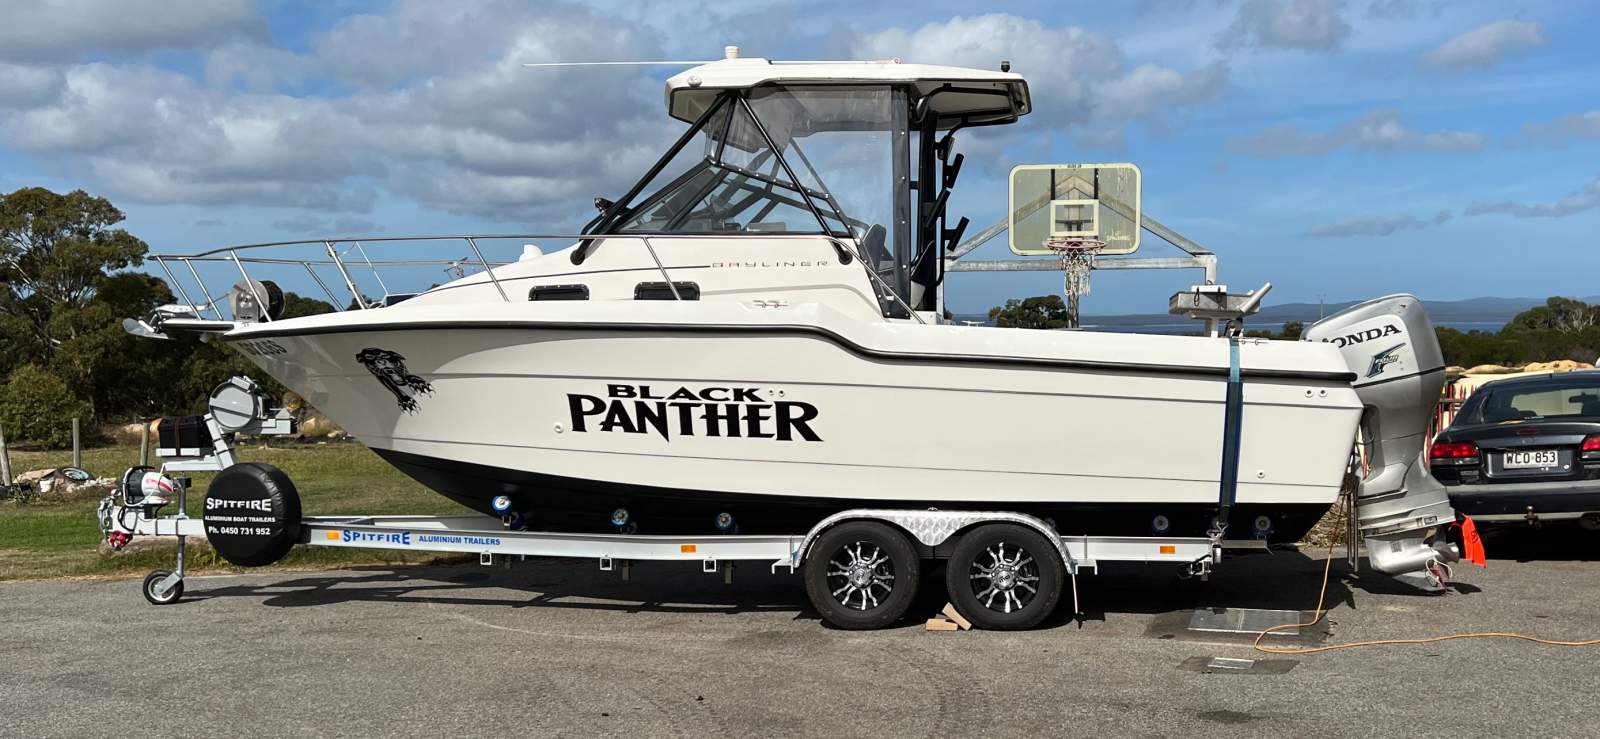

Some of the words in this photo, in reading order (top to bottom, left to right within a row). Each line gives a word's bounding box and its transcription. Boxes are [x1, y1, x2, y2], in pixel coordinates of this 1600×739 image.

[1308, 324, 1402, 348] ONDA
[607, 384, 766, 402] BLACK
[566, 393, 824, 442] PANTHER
[1506, 452, 1530, 464] WCO
[1535, 452, 1556, 463] 853
[206, 497, 272, 512] SPITFIRE
[208, 526, 219, 534] Ph.
[220, 526, 239, 535] 0450
[240, 527, 253, 535] 731
[255, 527, 271, 535] 952
[343, 529, 411, 545] SPITFIRE
[418, 535, 462, 544] ALUMINIUM
[463, 536, 501, 546] TRAILERS
